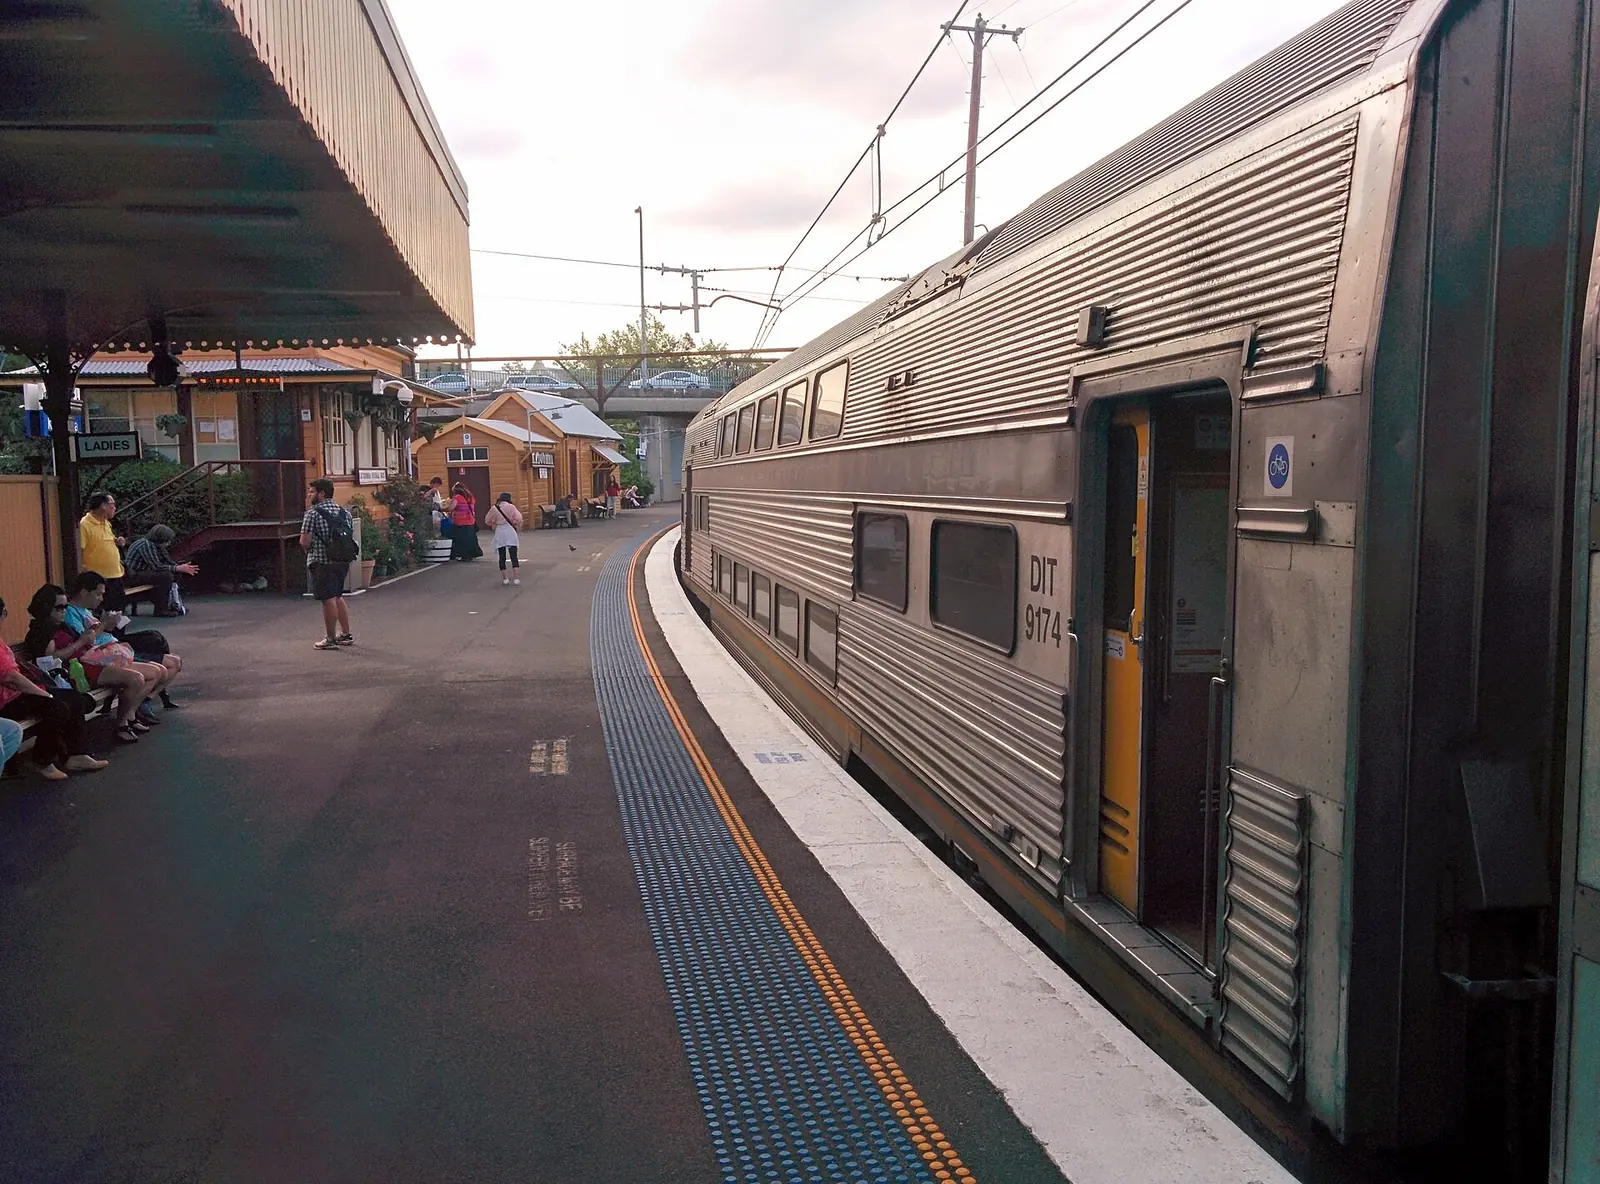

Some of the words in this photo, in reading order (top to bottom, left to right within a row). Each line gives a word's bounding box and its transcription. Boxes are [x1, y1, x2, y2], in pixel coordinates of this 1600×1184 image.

[84, 440, 130, 451] LADIES
[1030, 555, 1058, 596] DIT
[1025, 603, 1062, 648] 9174
